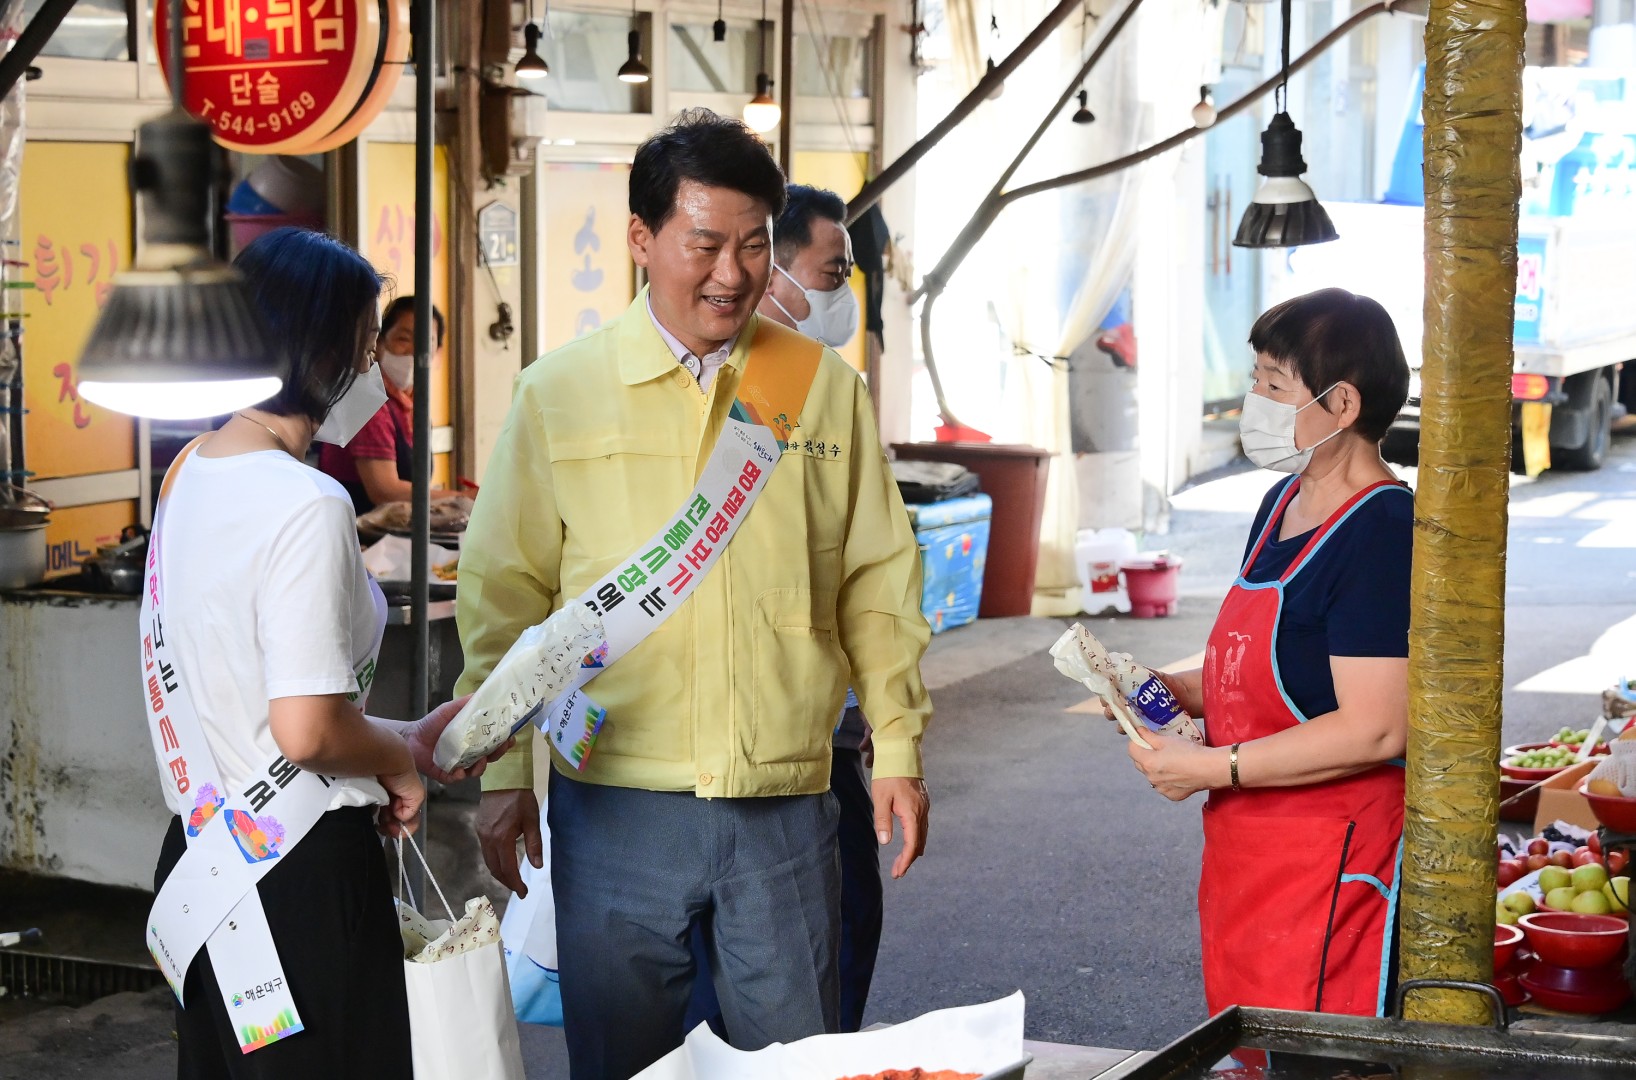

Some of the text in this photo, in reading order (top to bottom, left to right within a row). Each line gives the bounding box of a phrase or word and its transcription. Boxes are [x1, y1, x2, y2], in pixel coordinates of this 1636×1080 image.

[229, 70, 280, 106] 단술
[200, 91, 316, 136] T.544-9189
[143, 632, 191, 795] 전통시장
[244, 977, 283, 1002] 해운대구
